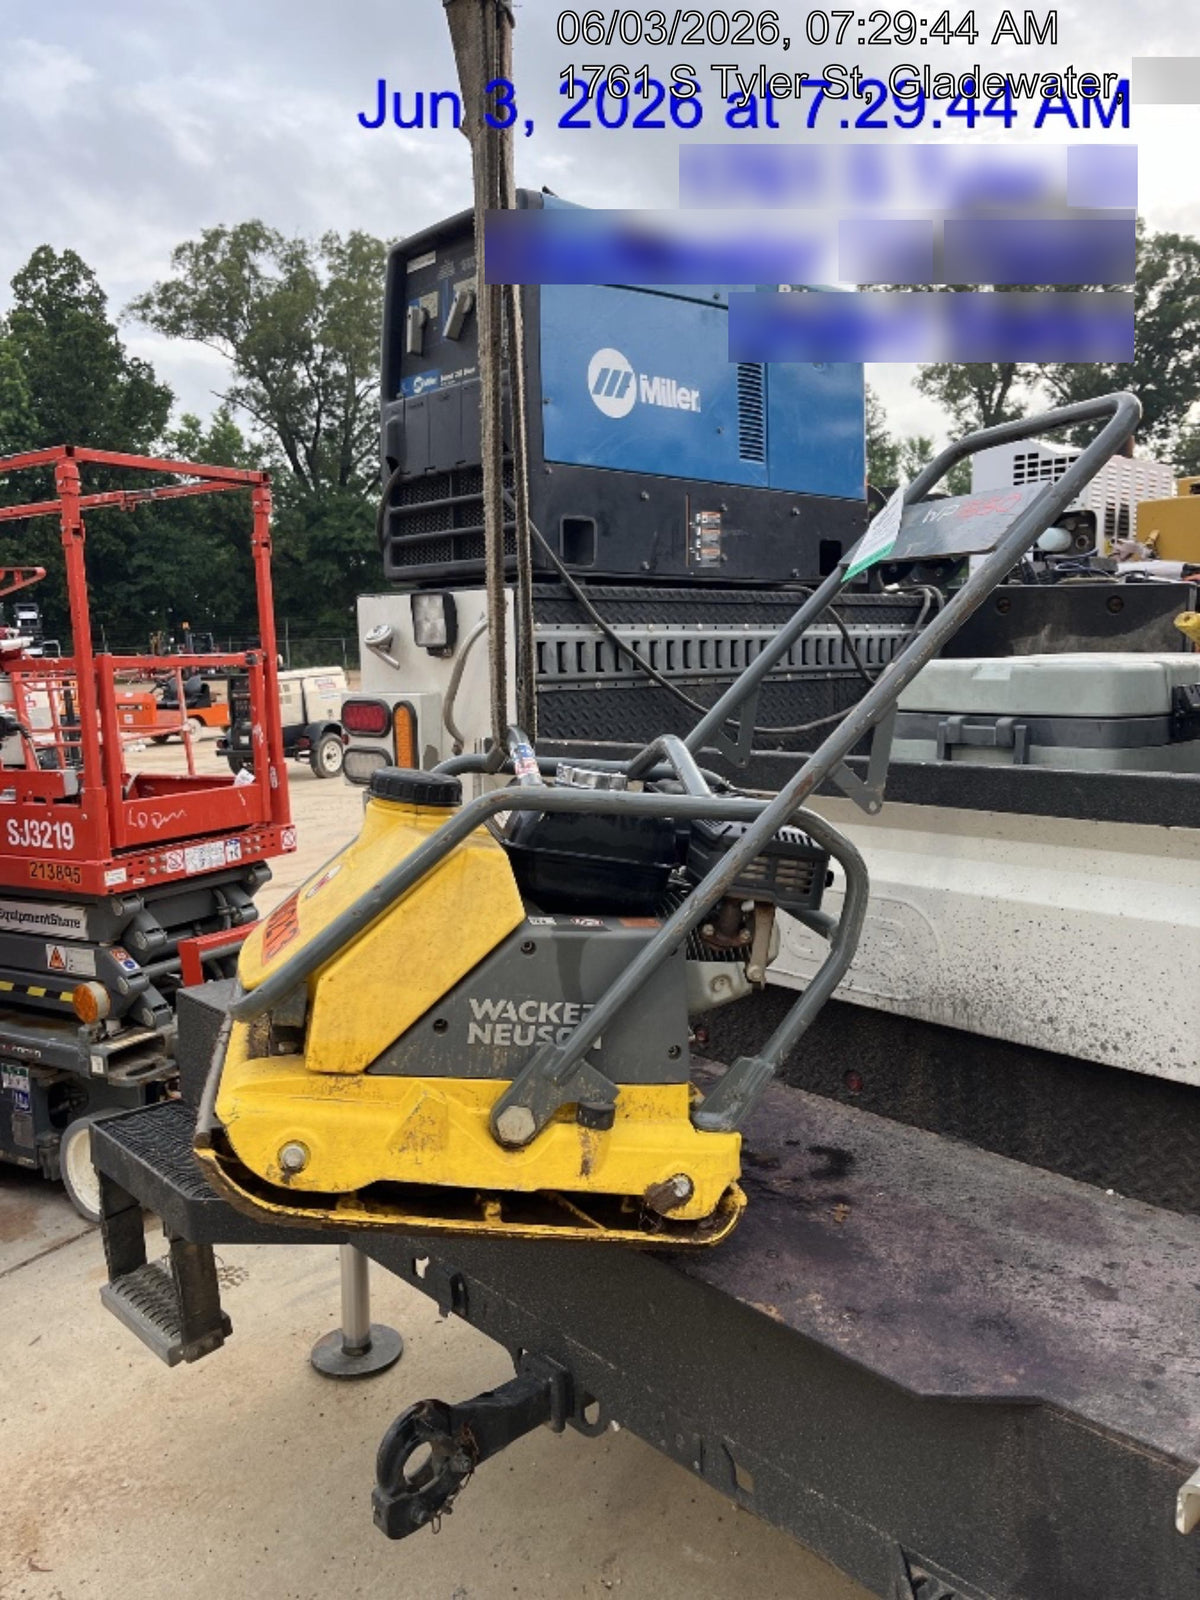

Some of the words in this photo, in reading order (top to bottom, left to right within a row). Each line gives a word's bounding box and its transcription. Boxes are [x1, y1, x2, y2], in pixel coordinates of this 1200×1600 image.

[640, 373, 701, 413] Miller
[6, 819, 75, 850] SJ3219
[29, 861, 82, 884] 213895
[466, 1022, 602, 1050] NEUSO
